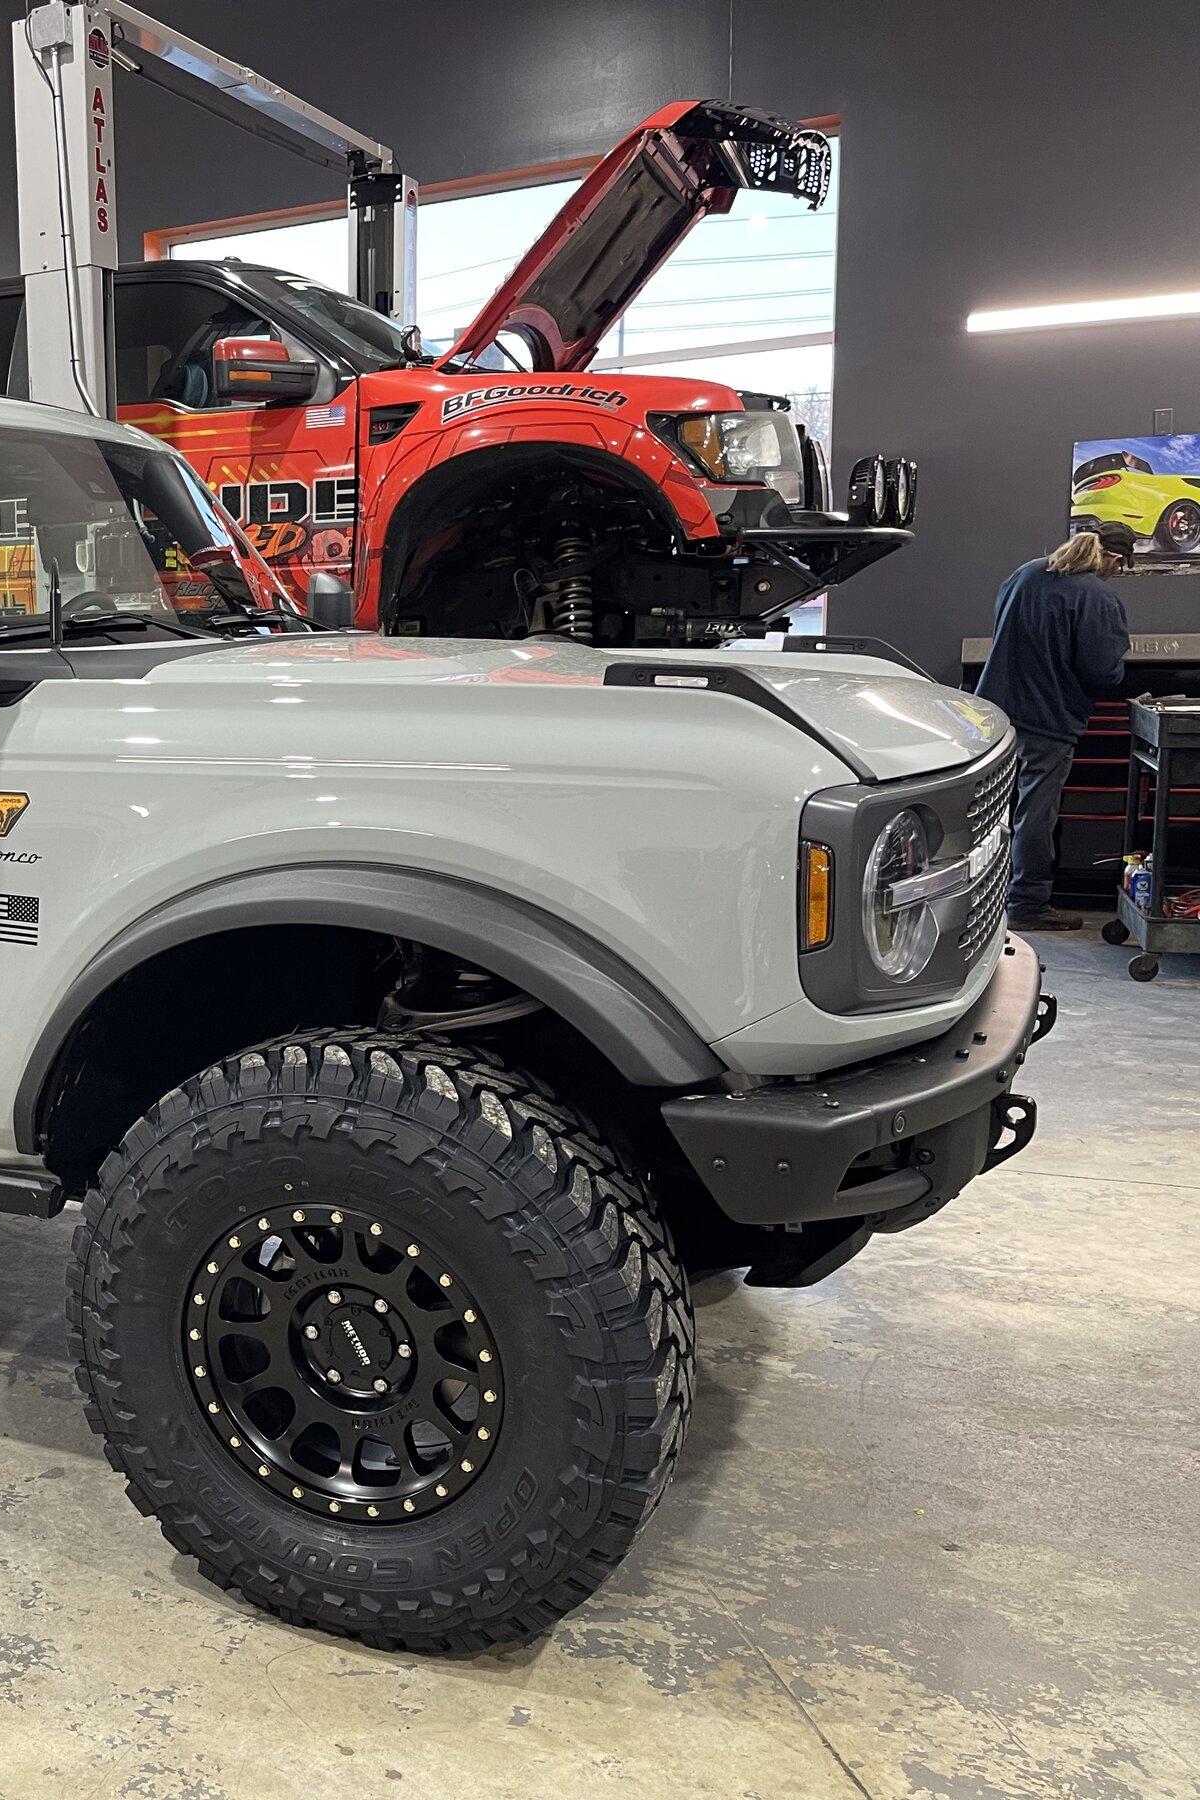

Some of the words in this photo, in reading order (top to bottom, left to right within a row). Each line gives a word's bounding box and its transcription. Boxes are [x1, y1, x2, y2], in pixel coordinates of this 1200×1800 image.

[91, 86, 109, 234] ATLAS
[442, 383, 629, 418] BFGoodrich
[343, 1319, 371, 1365] METHOD
[172, 1458, 415, 1585] COUNTRY
[432, 1465, 540, 1577] OPEN
